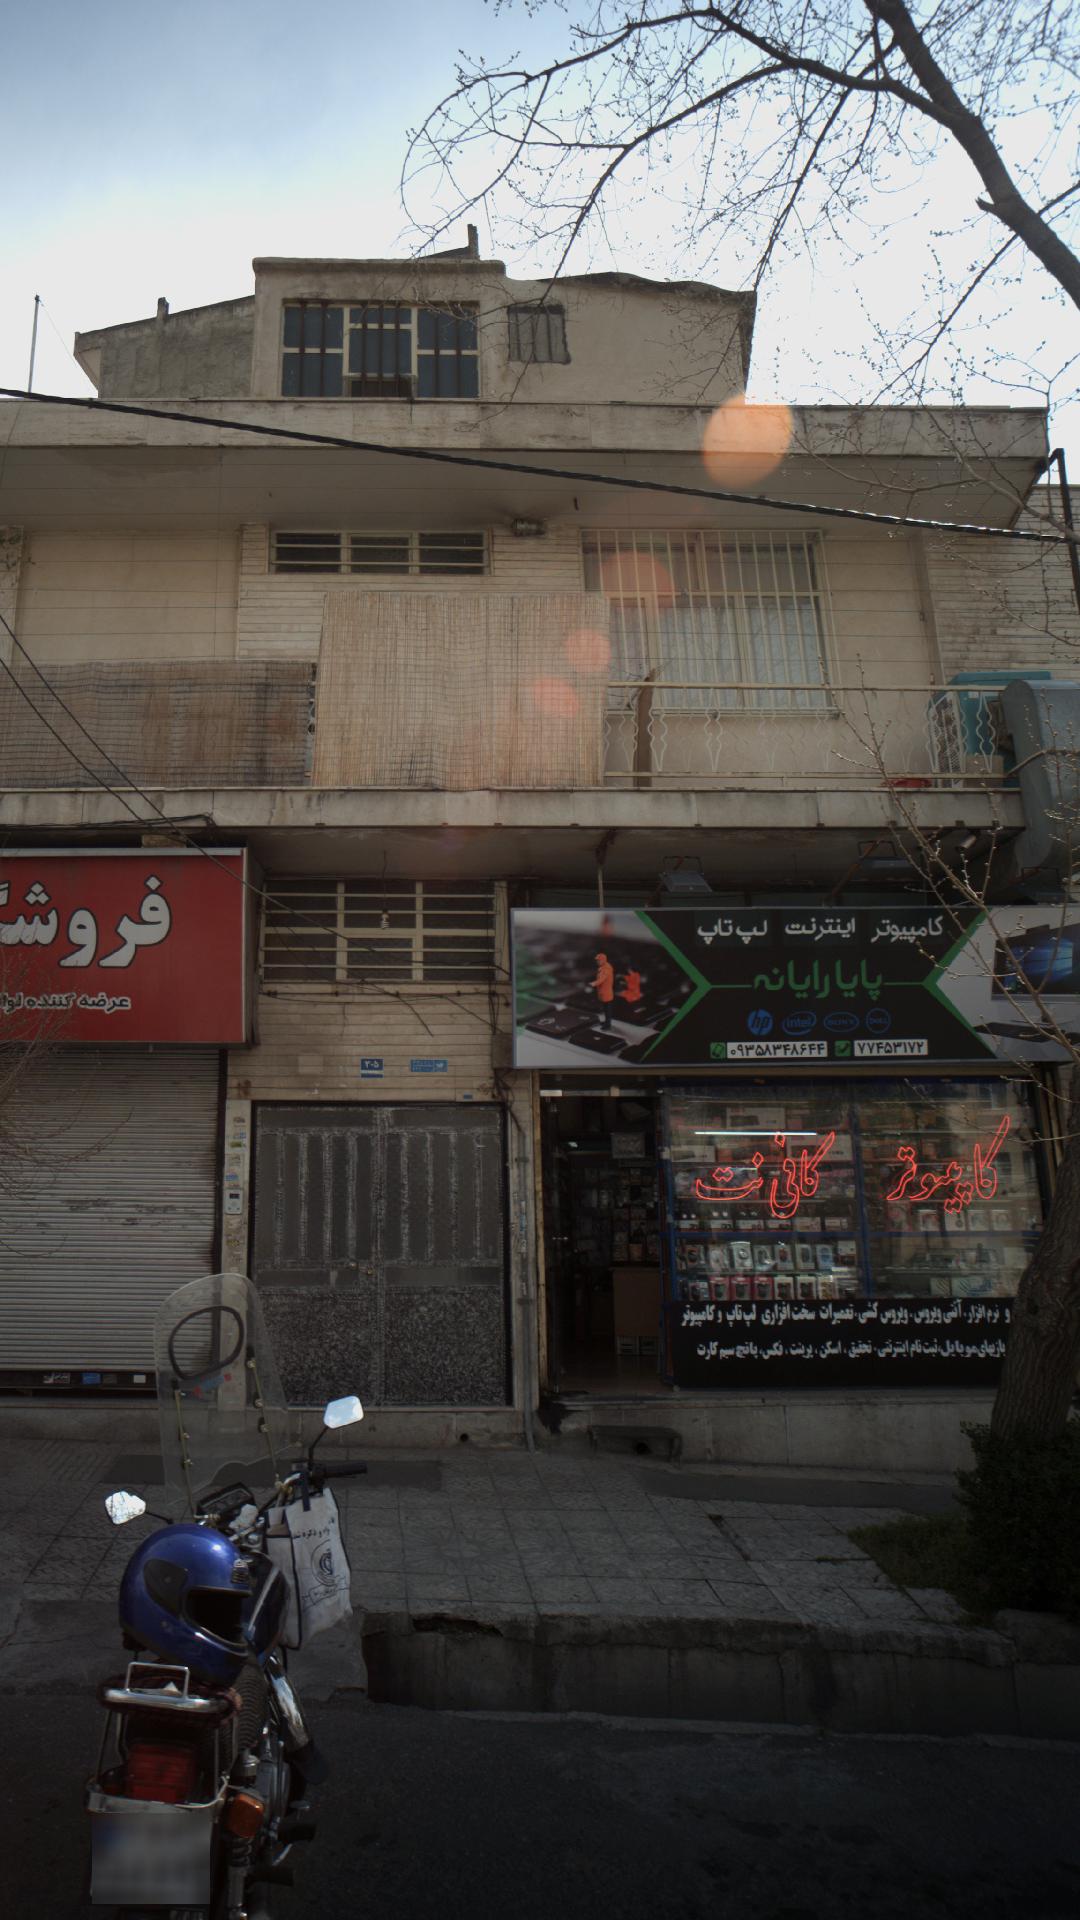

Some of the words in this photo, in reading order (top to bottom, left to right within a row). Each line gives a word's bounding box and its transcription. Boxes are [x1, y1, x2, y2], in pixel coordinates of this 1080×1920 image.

[0, 876, 172, 968] فروش
[785, 917, 856, 941] اینترنت
[871, 915, 943, 943] کامپیوتر
[0, 992, 24, 1014] لوا
[25, 993, 77, 1009] کننده
[78, 992, 131, 1014] عرضه
[857, 1041, 925, 1055] ۷۷۴۵۳۱۷۲
[695, 1151, 765, 1201] نت
[769, 1130, 836, 1219] کافی
[681, 1303, 716, 1328] کامپیوتر
[717, 1309, 723, 1323] و
[760, 1301, 791, 1325] افزاری
[791, 1303, 816, 1320] سخت
[819, 1302, 854, 1325] تعمیرات
[879, 1306, 909, 1325] ویروس
[943, 1298, 962, 1324] آنتی
[986, 1304, 1000, 1323] نرم
[1004, 1307, 1011, 1324] و
[697, 1341, 719, 1360] کارت
[719, 1346, 736, 1360] سیم
[910, 1339, 922, 1357] نام
[923, 1338, 938, 1357] ثبت
